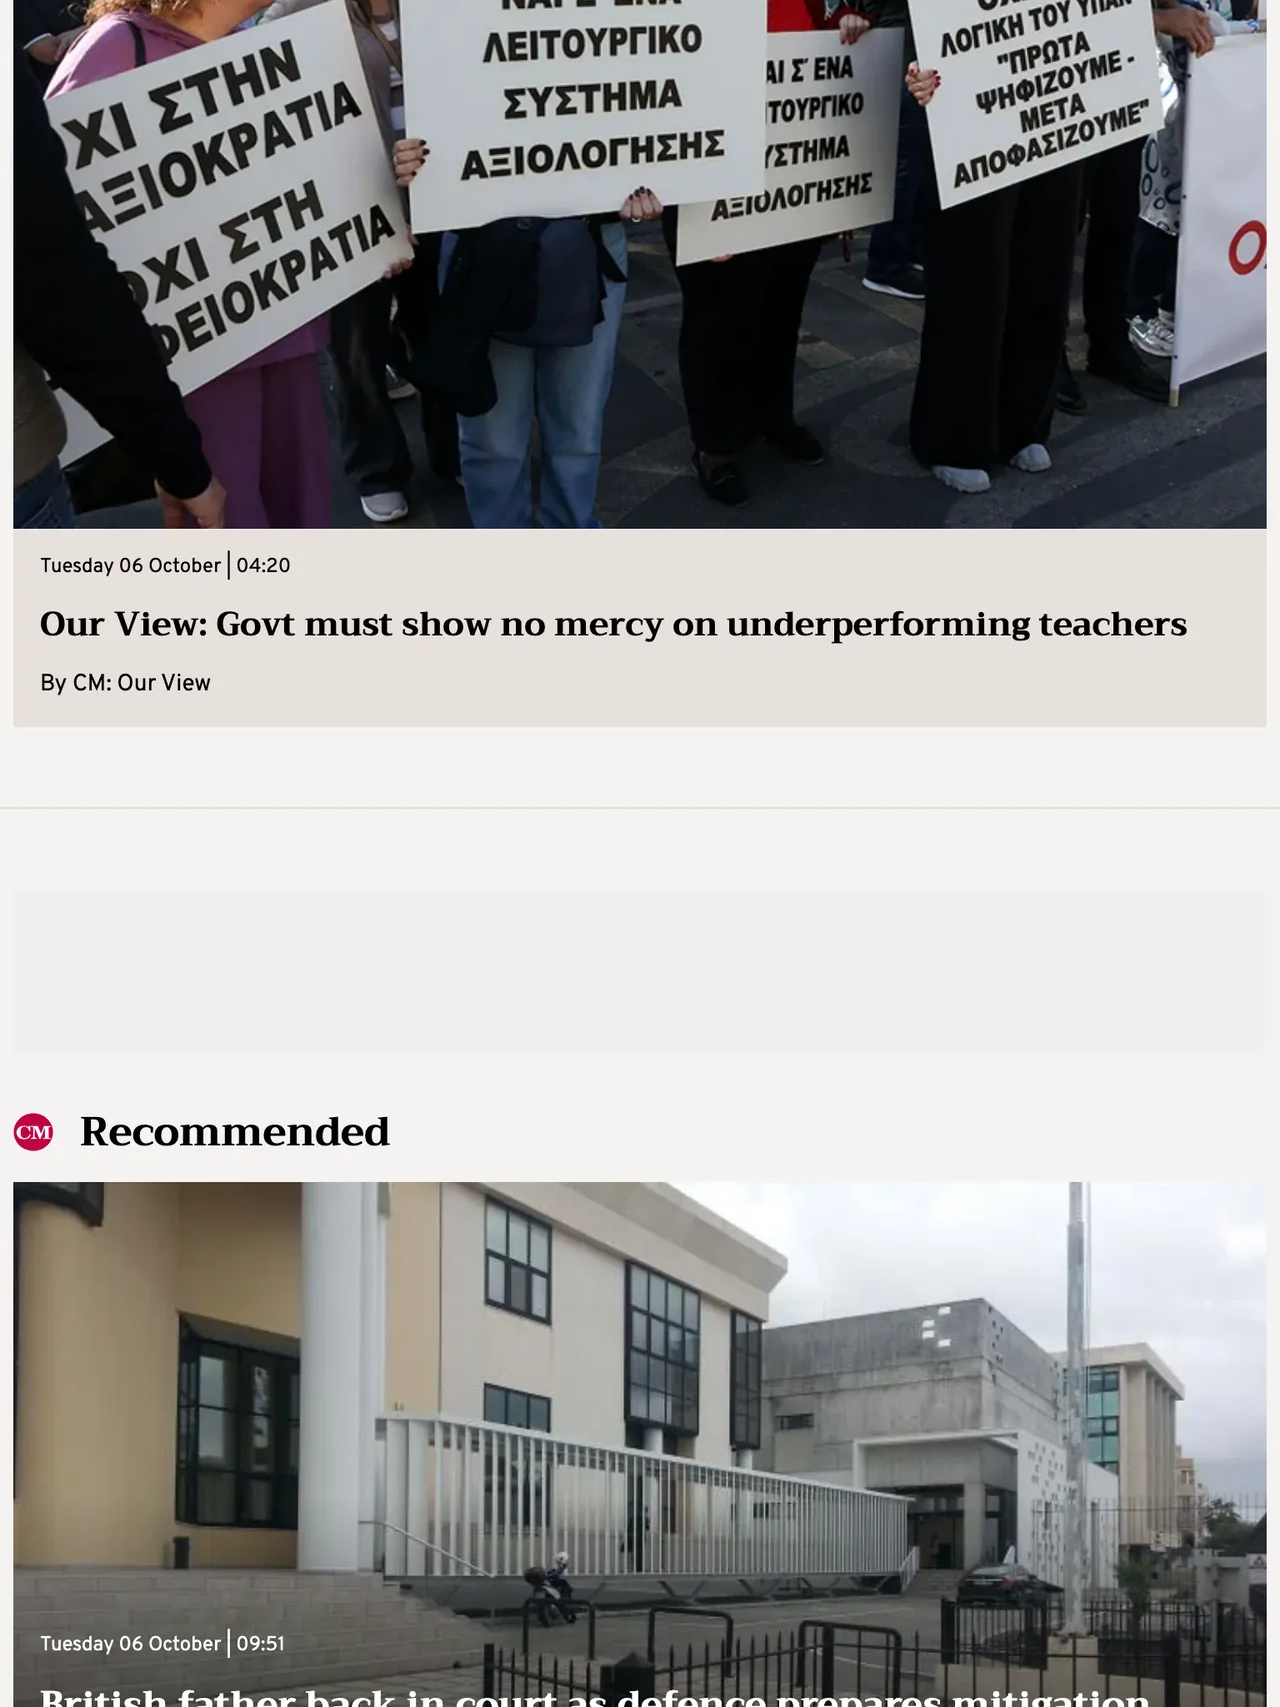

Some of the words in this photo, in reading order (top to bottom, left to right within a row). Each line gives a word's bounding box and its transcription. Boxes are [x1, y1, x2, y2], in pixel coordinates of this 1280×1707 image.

[482, 24, 702, 63] ΛΕΙΤΟΥΡΓΙΚΟ
[941, 12, 1025, 58] ΛΟΓΙΚΗ
[1028, 0, 1071, 31] ΤΟΥ
[766, 59, 784, 84] ΑΙ
[813, 55, 854, 81] ΕΝΑ
[975, 50, 1123, 114] ΨΗΦΙΖΟΥΜΕ
[61, 102, 137, 170] ΧΙ
[148, 39, 302, 135] ΣΤΗΝ
[504, 79, 682, 119] ΣΥΣΤΗΜΑ
[765, 92, 864, 124] ΤΟΥΡΓΙΚΟ
[1019, 93, 1086, 133] ΜΕΤΑ
[461, 129, 725, 181] ΑΞΙΟΛΟΓΗΣΗΣ
[765, 135, 850, 169] ΥΣΤΗΜΑ
[710, 172, 873, 222] ΑΞΙΟΛΟΓΗΣΗΣ
[219, 179, 325, 264] ΣΤΗ
[150, 204, 396, 366] ΦΕΙΟΚΡΑΤΙΑ
[40, 557, 115, 577] Tuesday
[119, 557, 144, 574] 06
[148, 556, 222, 573] October
[236, 556, 291, 574] 04:20
[40, 610, 106, 637] Our
[113, 610, 207, 637] View:
[216, 610, 296, 637] Govt
[304, 613, 394, 637] must
[402, 610, 493, 637] show
[500, 617, 546, 637] no
[554, 617, 665, 643] mercy
[672, 617, 719, 637] on
[726, 610, 1031, 645] underperforming
[1038, 610, 1188, 637] teachers
[41, 673, 67, 696] By
[73, 672, 112, 692] CM:
[117, 672, 157, 692] Our
[161, 672, 211, 692] View
[15, 1124, 52, 1141] CM
[80, 1116, 391, 1147] Recommended
[40, 1635, 114, 1655] Tuesday
[119, 1635, 143, 1651] 06
[148, 1635, 222, 1652] October
[237, 1635, 284, 1652] 09:51
